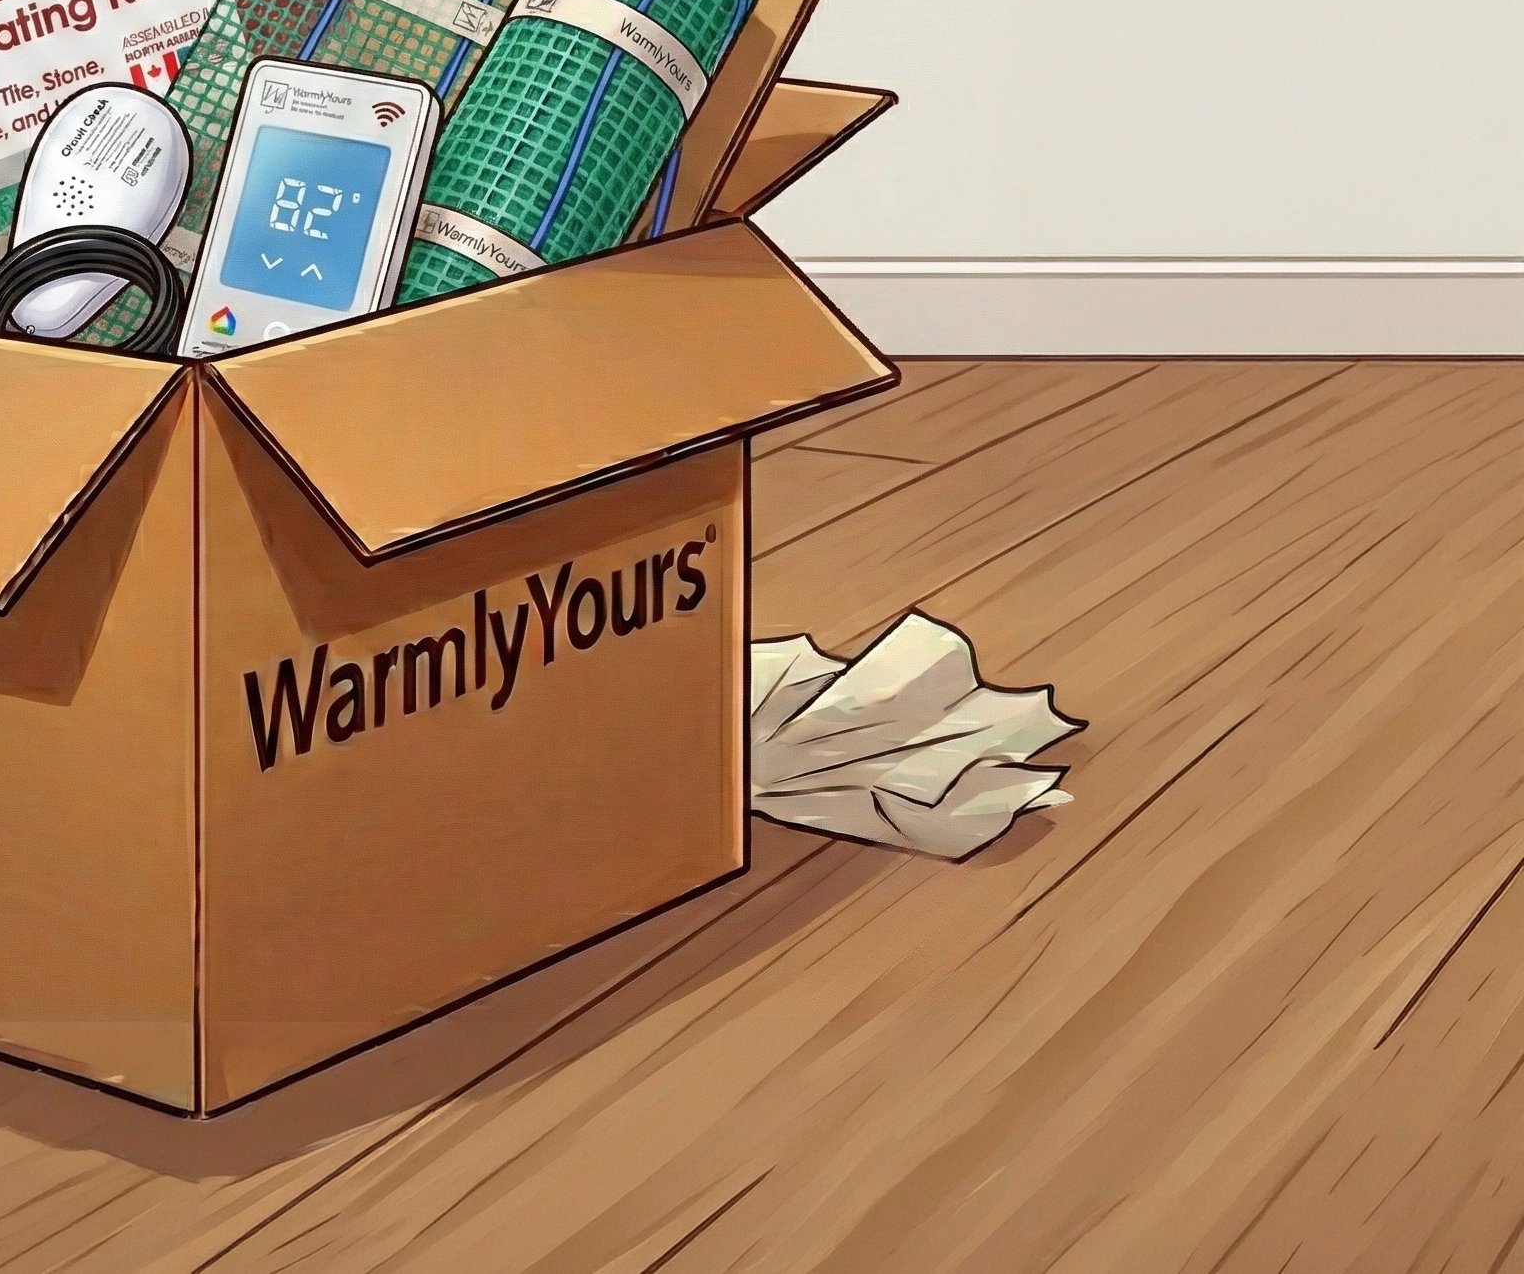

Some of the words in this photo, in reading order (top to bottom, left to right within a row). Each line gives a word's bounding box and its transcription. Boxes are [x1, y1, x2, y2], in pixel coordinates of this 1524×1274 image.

[619, 17, 693, 92] WarmlyYours
[42, 60, 106, 92] Stone,
[11, 103, 52, 133] and
